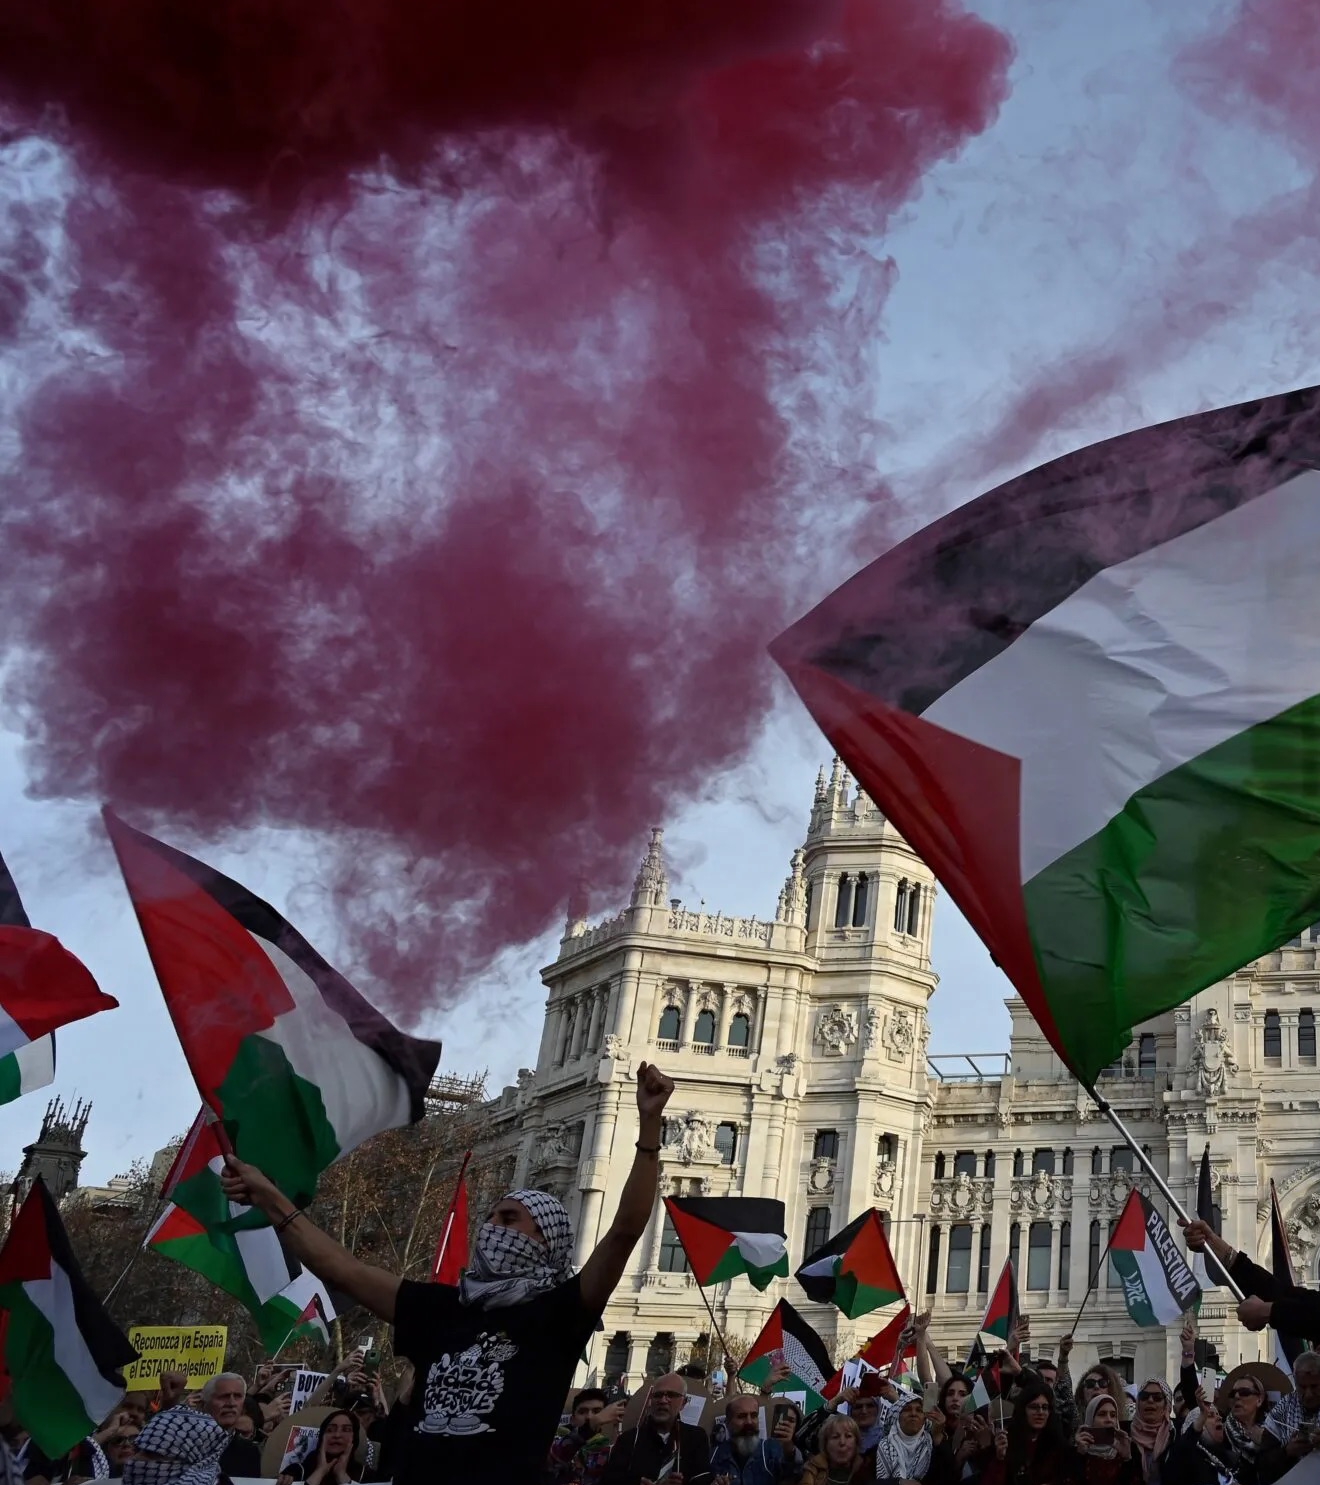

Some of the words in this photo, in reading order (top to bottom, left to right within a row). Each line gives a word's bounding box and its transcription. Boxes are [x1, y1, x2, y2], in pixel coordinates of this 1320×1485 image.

[1147, 1210, 1197, 1301] PALESTINA
[181, 1335, 191, 1353] ya
[193, 1331, 223, 1352] España
[129, 1361, 138, 1379] el
